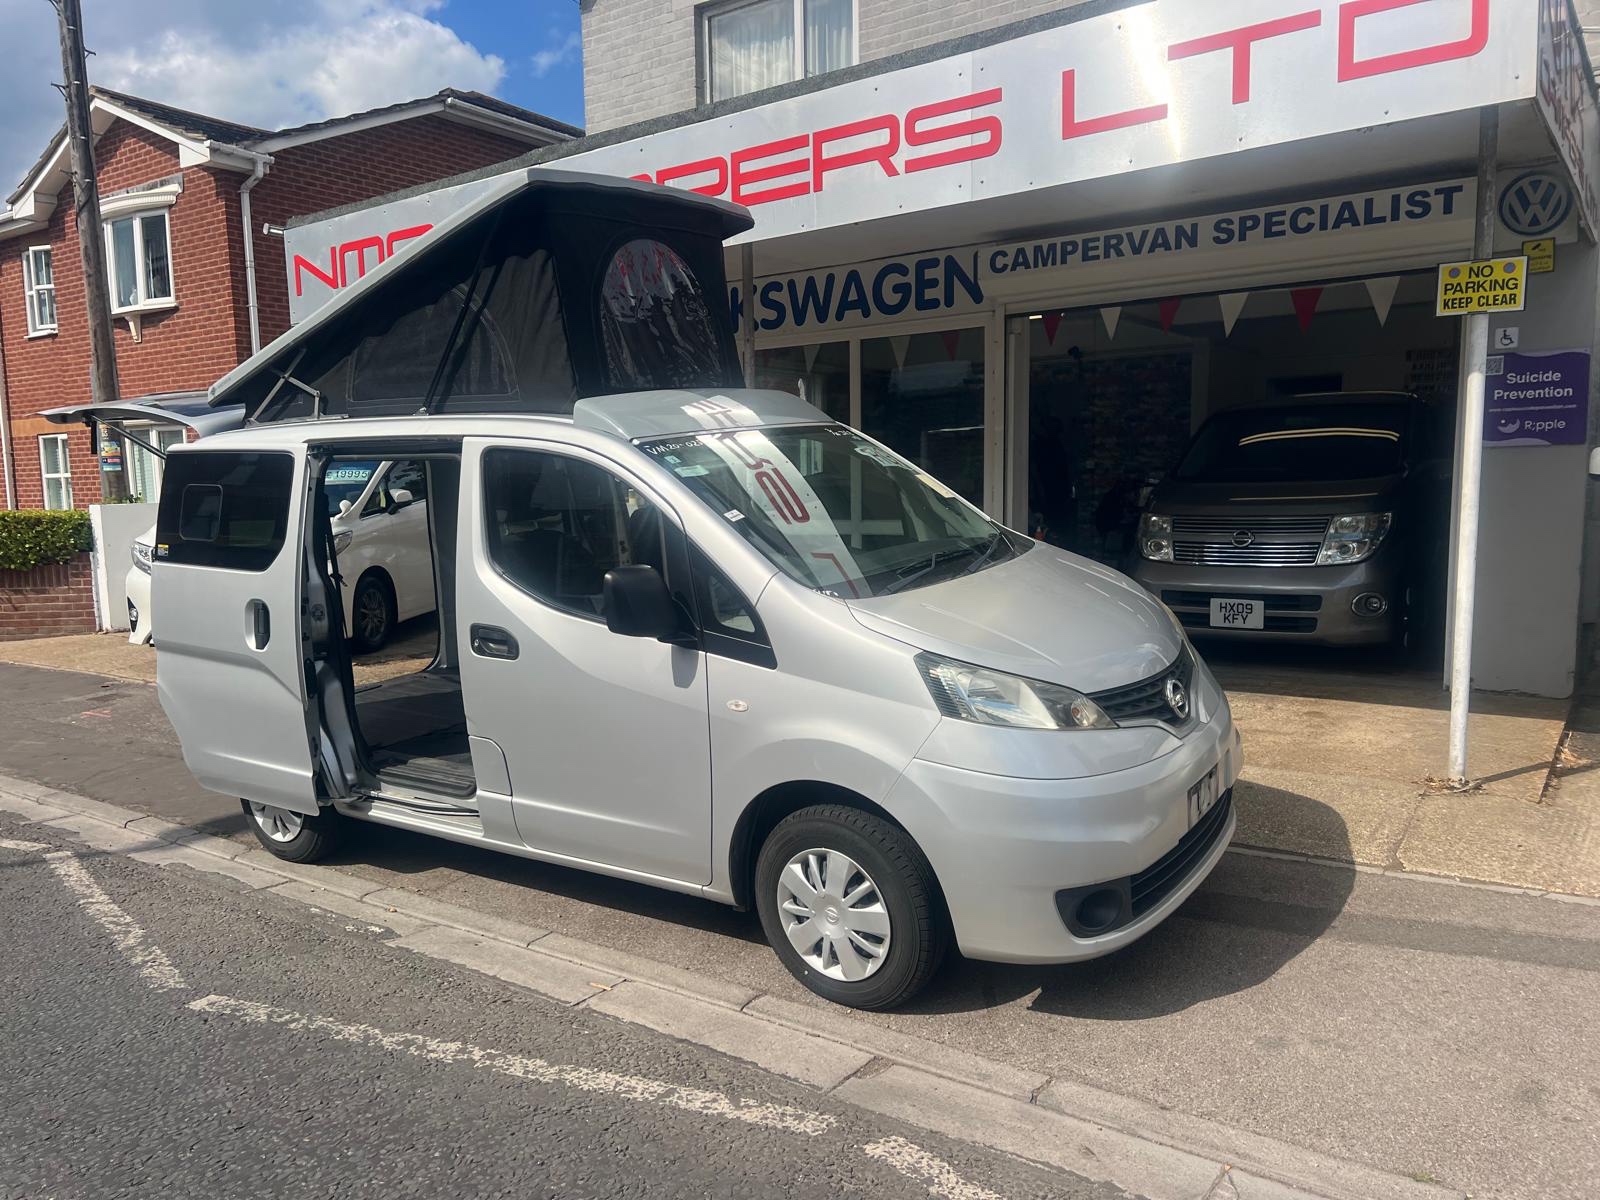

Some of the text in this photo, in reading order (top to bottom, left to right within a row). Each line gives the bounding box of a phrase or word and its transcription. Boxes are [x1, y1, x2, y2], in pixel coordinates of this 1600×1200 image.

[626, 87, 1003, 207] PERS
[1062, 0, 1489, 140] LTD
[988, 184, 1464, 275] CAMPERVAN SPECIALIST
[1468, 265, 1494, 279] NO
[1443, 277, 1519, 296] PARKING
[1443, 293, 1517, 310] KEEP CLEAR
[1506, 370, 1562, 384] Suicide
[1494, 386, 1573, 400] Prevention
[1219, 602, 1253, 614] HX09
[1223, 613, 1249, 625] KFY
